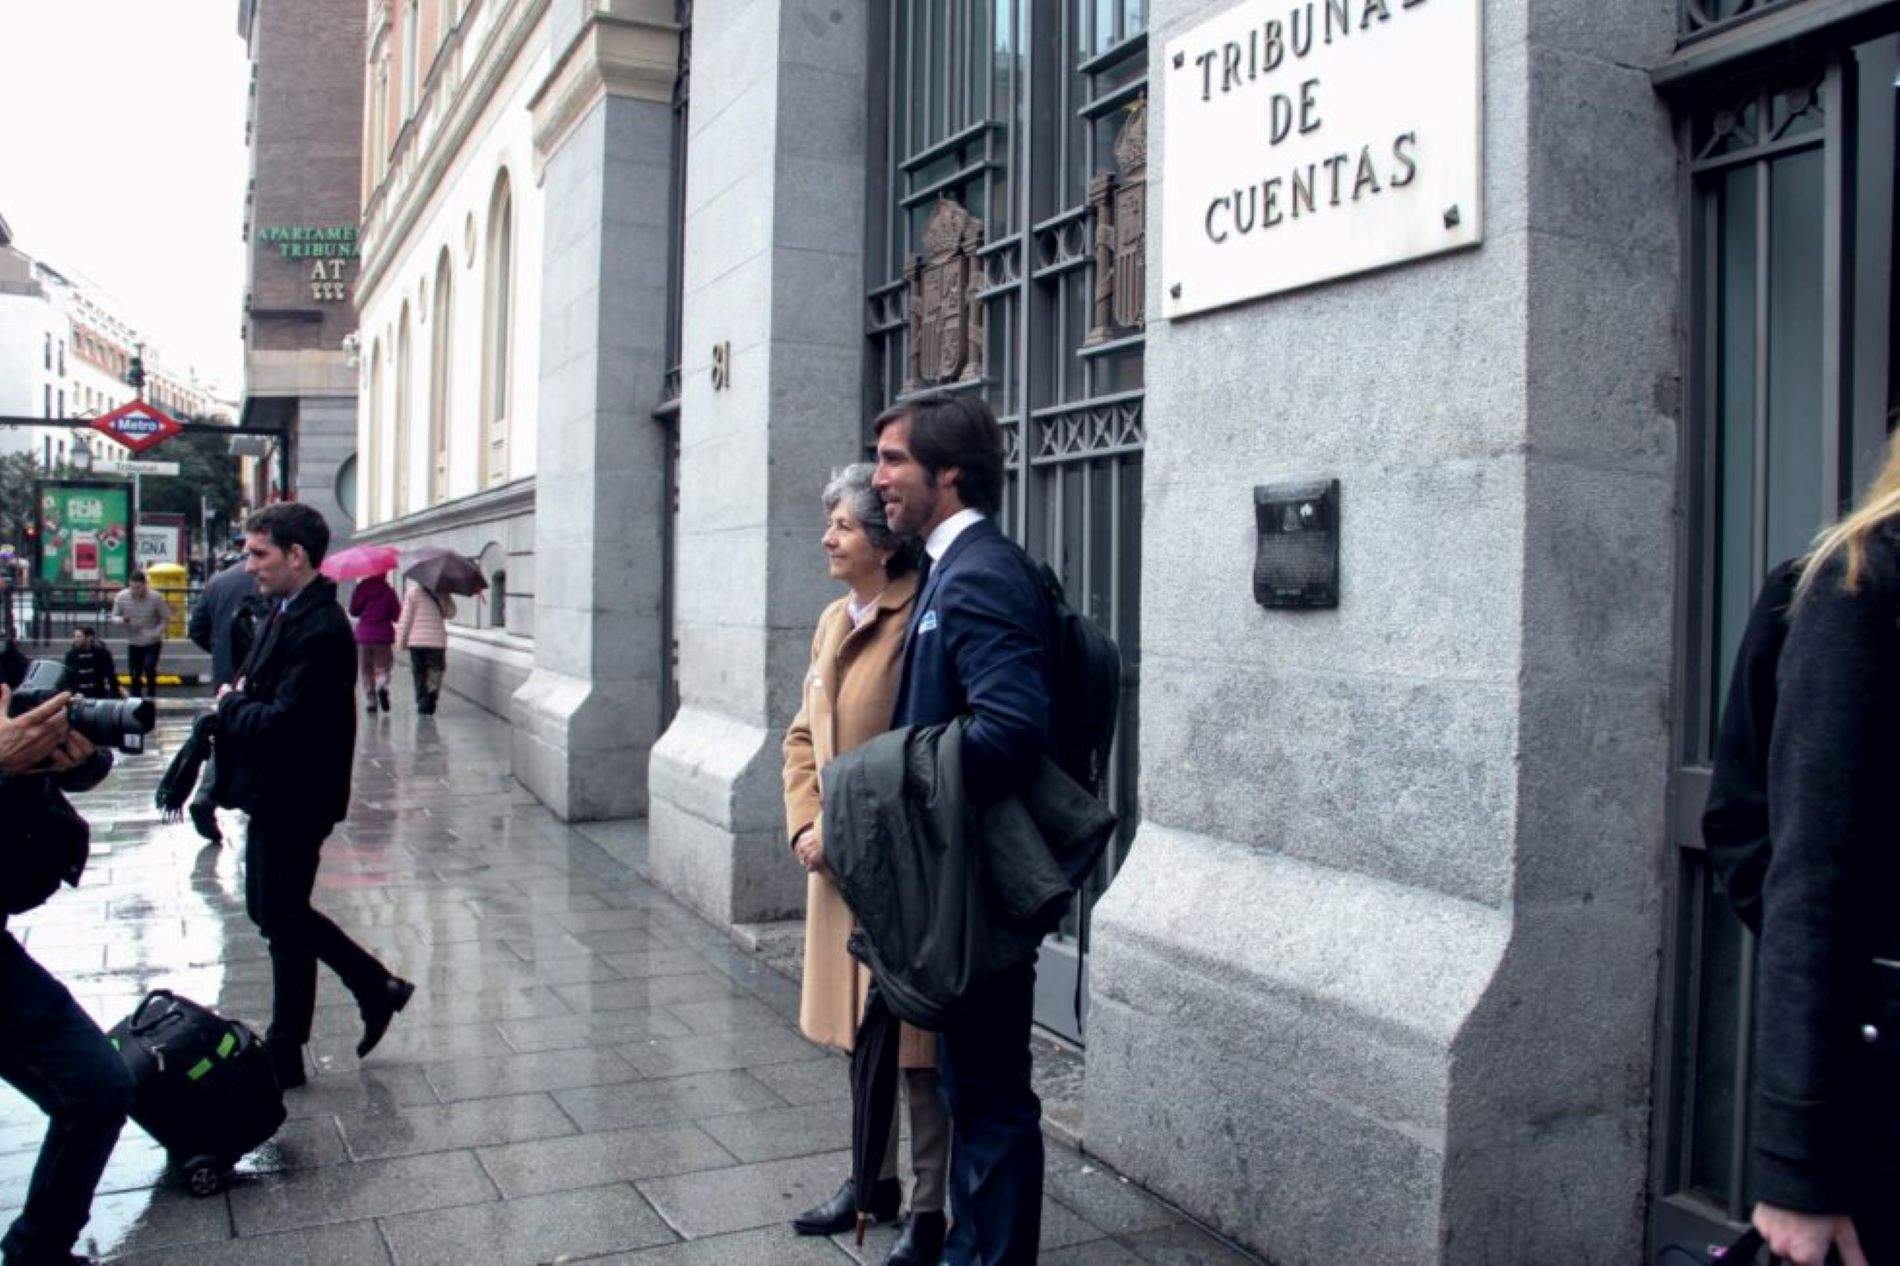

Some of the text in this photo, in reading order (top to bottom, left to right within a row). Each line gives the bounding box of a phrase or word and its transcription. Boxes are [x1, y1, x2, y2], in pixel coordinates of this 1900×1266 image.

[1195, 0, 1427, 101] TRIBUNA
[1269, 78, 1321, 146] DE
[1205, 131, 1416, 243] CUENTAS
[311, 259, 345, 281] AT
[117, 418, 157, 431] Metro
